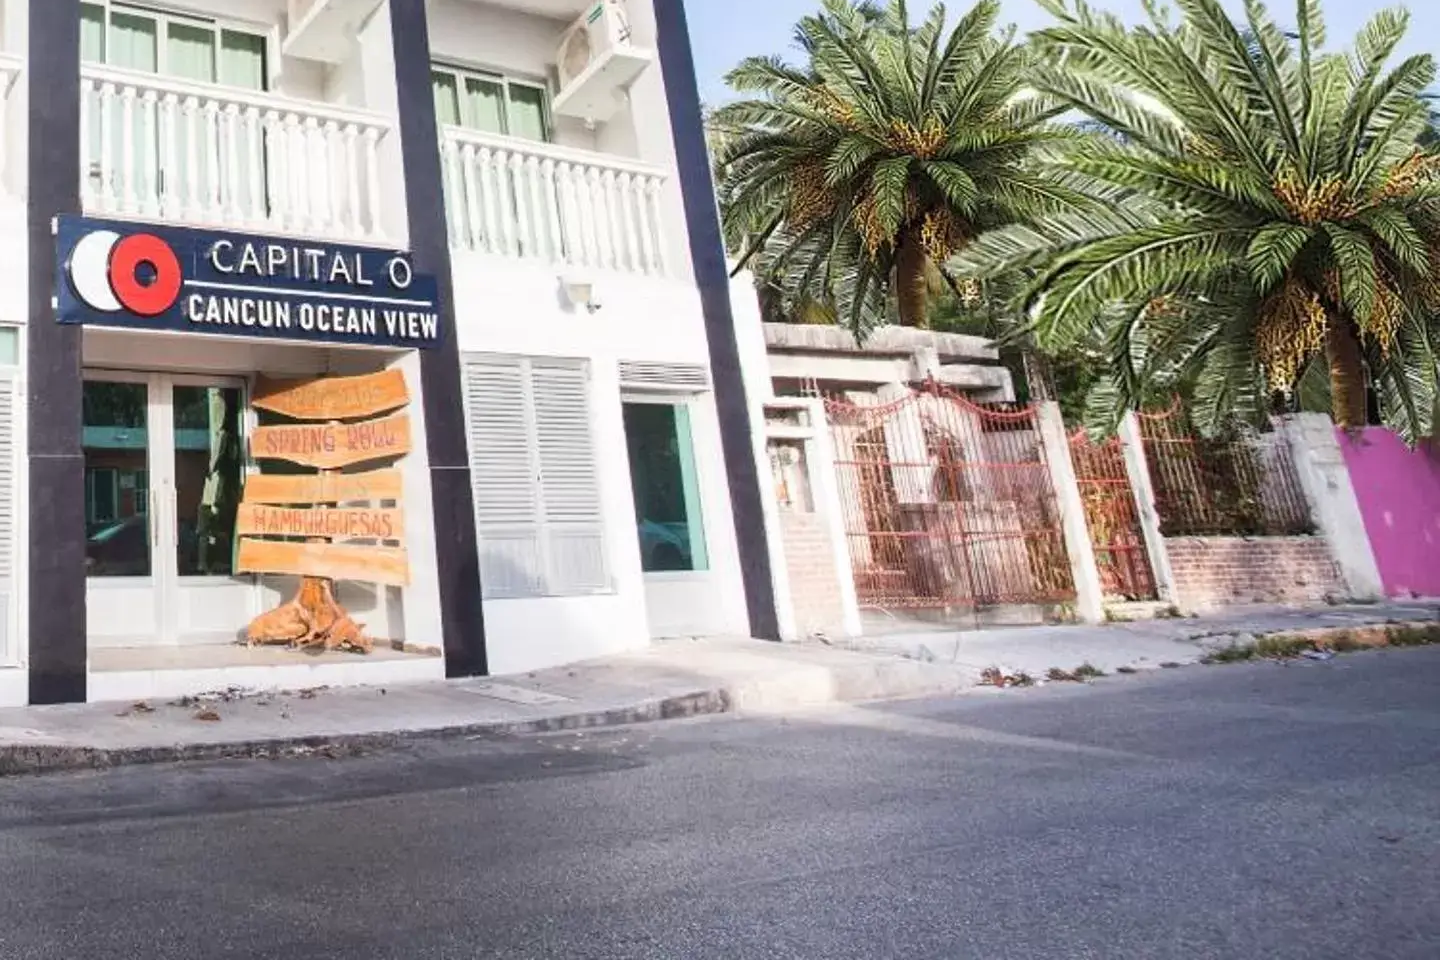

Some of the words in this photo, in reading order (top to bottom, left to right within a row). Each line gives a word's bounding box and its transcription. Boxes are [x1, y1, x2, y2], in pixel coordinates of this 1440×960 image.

[212, 240, 374, 286] CAPITAL
[389, 257, 412, 289] O
[188, 294, 291, 327] CANCUN
[299, 303, 377, 335] OCEAN
[384, 311, 438, 339] VIEW
[252, 508, 393, 537] HAMBURGUESAS
